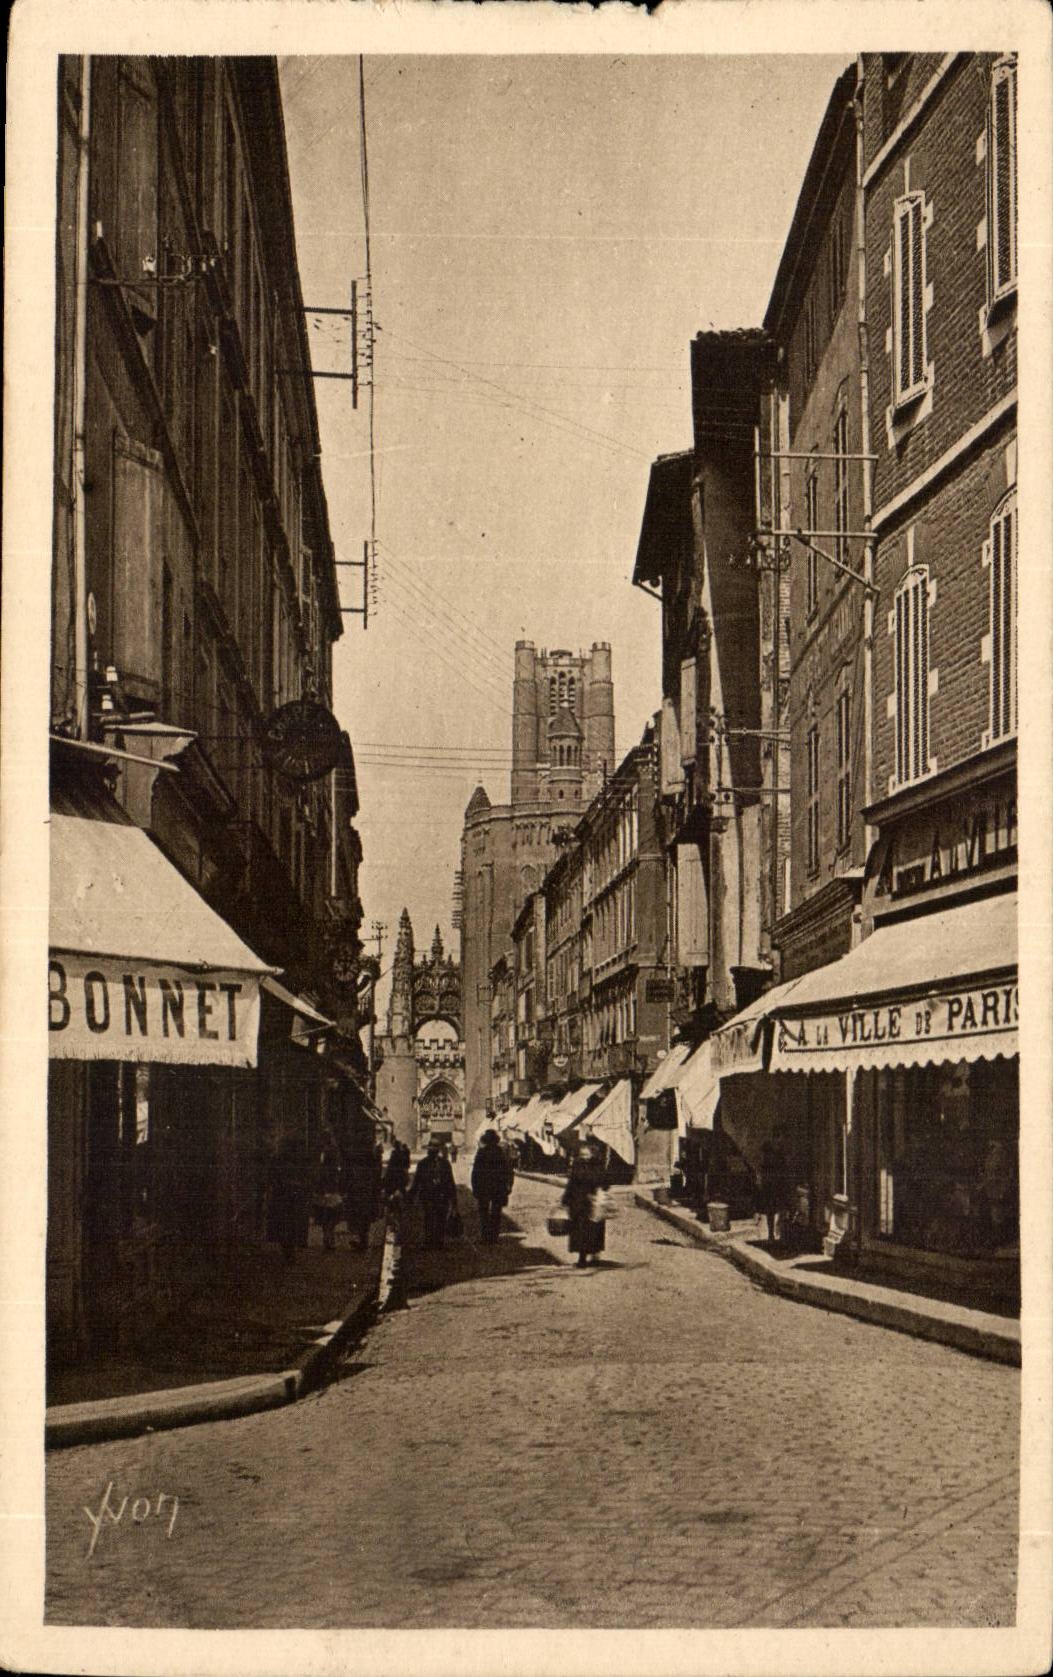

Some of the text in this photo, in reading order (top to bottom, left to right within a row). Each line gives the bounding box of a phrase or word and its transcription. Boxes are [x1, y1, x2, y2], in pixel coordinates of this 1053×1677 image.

[48, 961, 242, 1041] BONNET
[797, 1019, 808, 1046] A
[838, 1007, 902, 1044] VILLE
